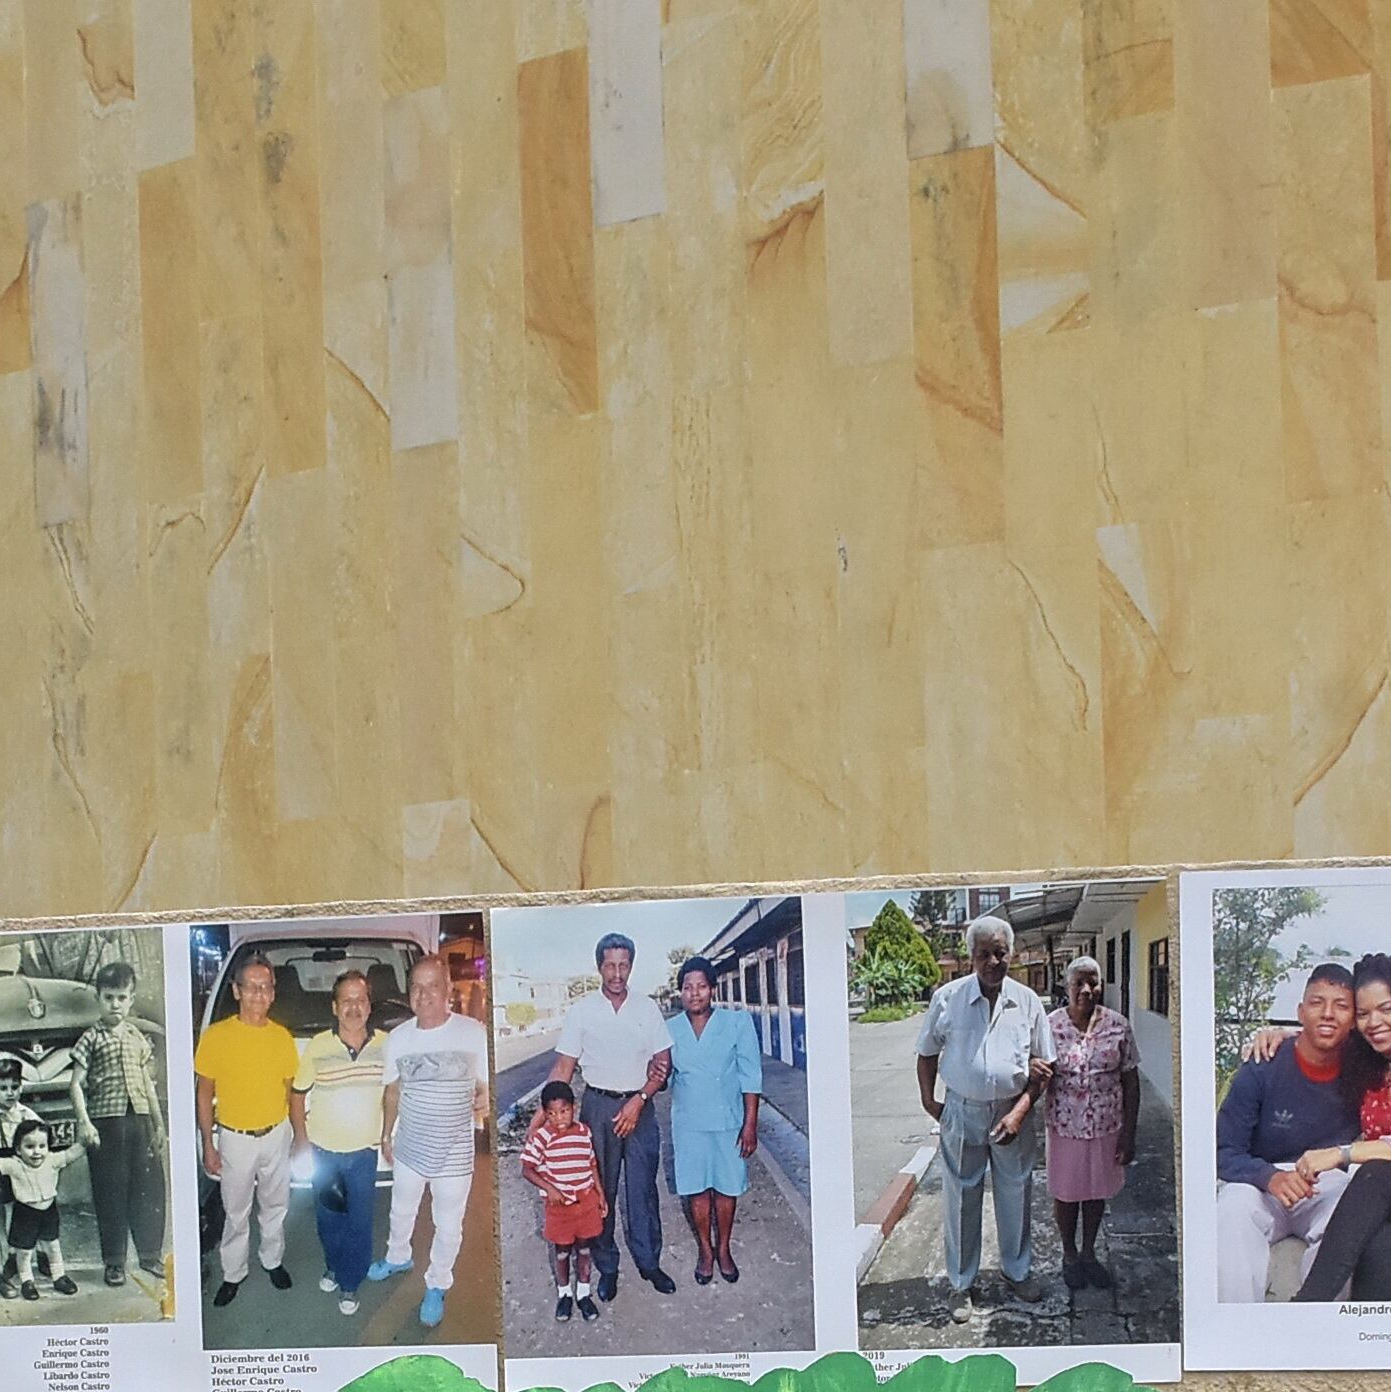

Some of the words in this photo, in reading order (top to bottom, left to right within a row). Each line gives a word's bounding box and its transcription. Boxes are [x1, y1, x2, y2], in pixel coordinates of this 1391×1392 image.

[79, 1338, 109, 1346] Castro
[42, 1349, 78, 1359] Enrique
[79, 1349, 109, 1357] Castro
[211, 1354, 265, 1363] Diciembre
[267, 1353, 284, 1362] del
[286, 1353, 309, 1362] 2016
[33, 1360, 78, 1369] Guillermo
[80, 1360, 109, 1368] Castro
[210, 1366, 234, 1375] Jose
[237, 1365, 279, 1375] Enrique
[282, 1364, 317, 1373] Castro
[43, 1371, 79, 1380] Libardo
[80, 1371, 110, 1379] Castro
[249, 1377, 284, 1385] Castro
[48, 1383, 79, 1391] Nelson
[81, 1382, 110, 1390] Castro
